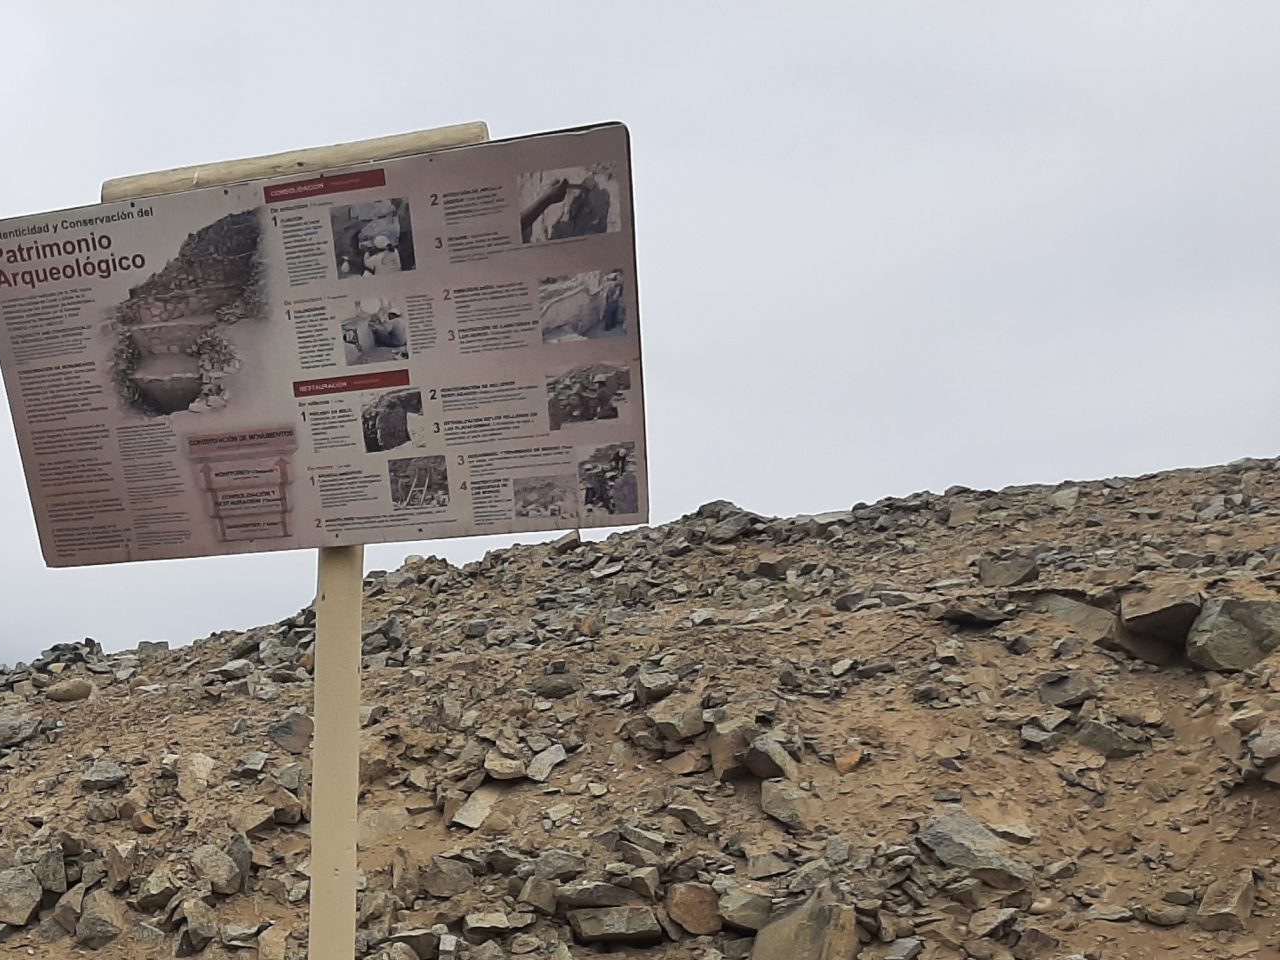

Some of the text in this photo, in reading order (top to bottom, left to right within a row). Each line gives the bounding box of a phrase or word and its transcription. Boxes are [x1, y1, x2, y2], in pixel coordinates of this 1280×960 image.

[429, 193, 439, 207] 2
[52, 222, 58, 234] y
[61, 210, 135, 230] Conservación
[137, 207, 154, 218] del
[271, 216, 278, 228] 1
[434, 236, 443, 249] 3
[442, 289, 452, 301] 2
[285, 309, 292, 321] 1
[447, 329, 456, 341] 3
[429, 388, 437, 401] 2
[300, 411, 307, 422] 1
[433, 422, 441, 434] 3
[457, 455, 465, 466] 3
[309, 475, 316, 487] 1
[459, 481, 468, 491] 4
[314, 518, 322, 528] 2
